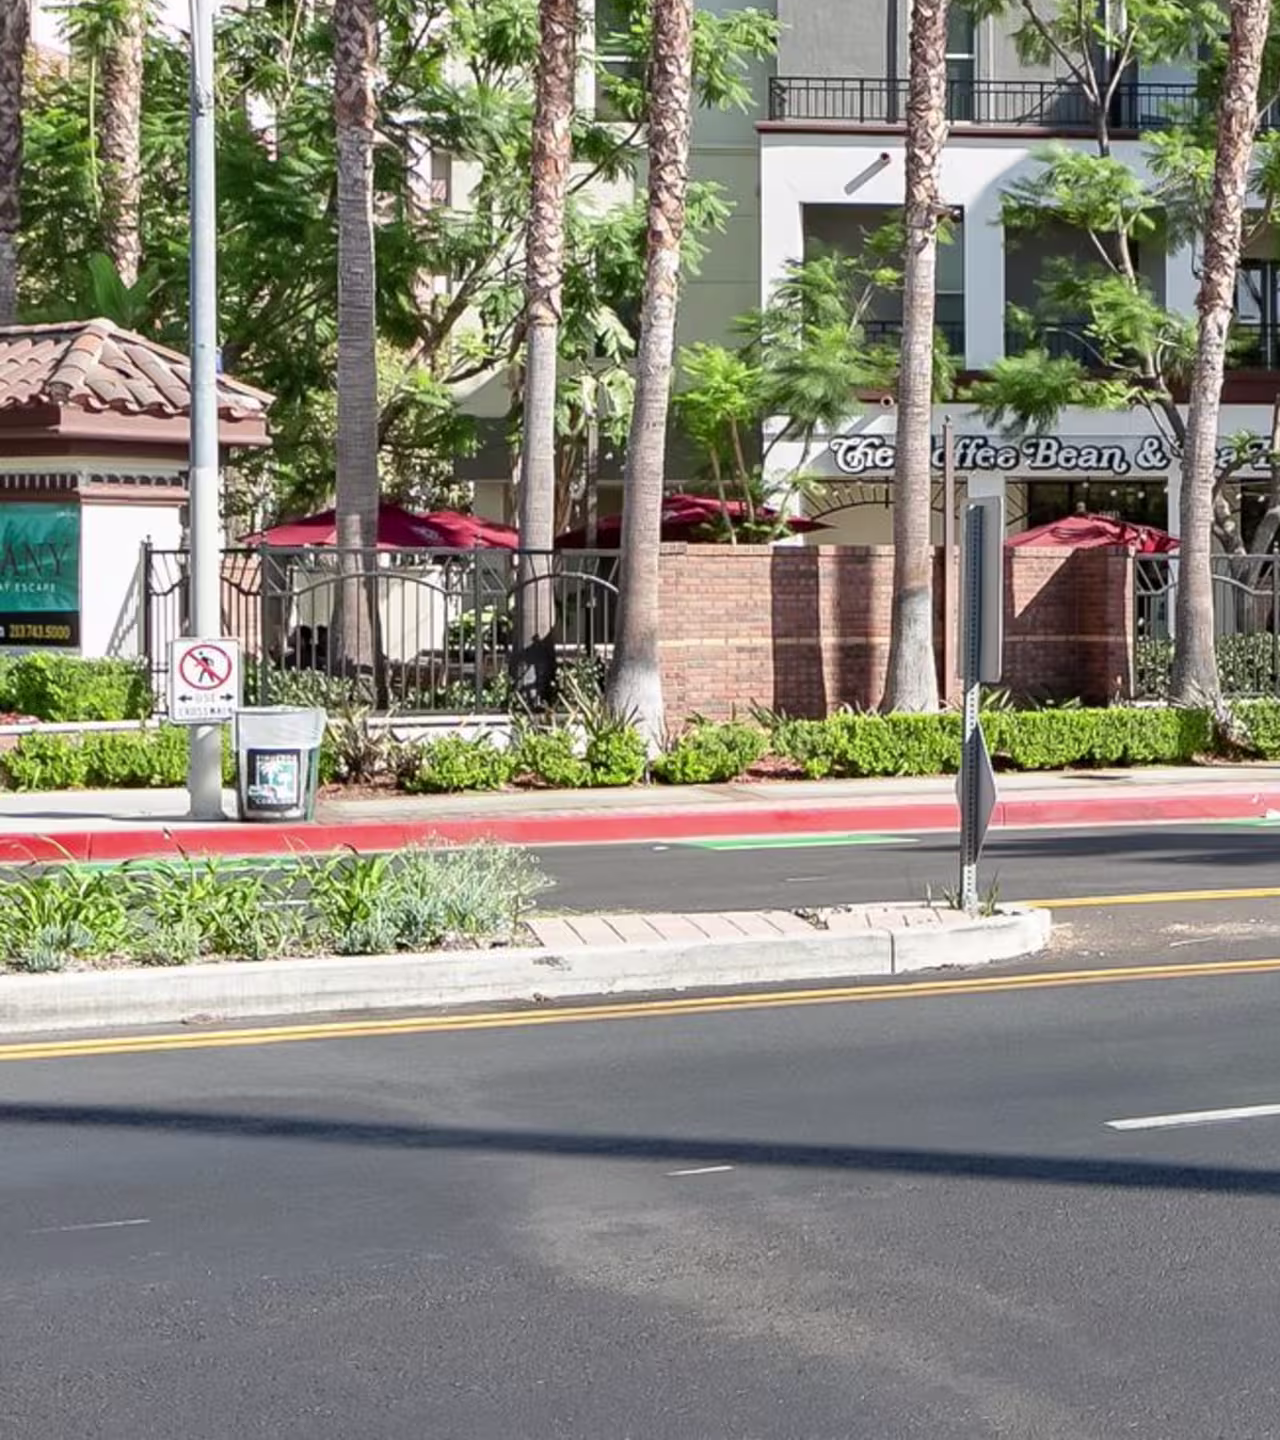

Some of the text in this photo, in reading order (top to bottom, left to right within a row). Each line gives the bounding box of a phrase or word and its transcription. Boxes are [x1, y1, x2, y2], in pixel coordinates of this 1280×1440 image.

[830, 437, 895, 474] The
[1022, 437, 1129, 473] Bean
[1136, 436, 1168, 470] &
[14, 582, 57, 593] ESCAPE
